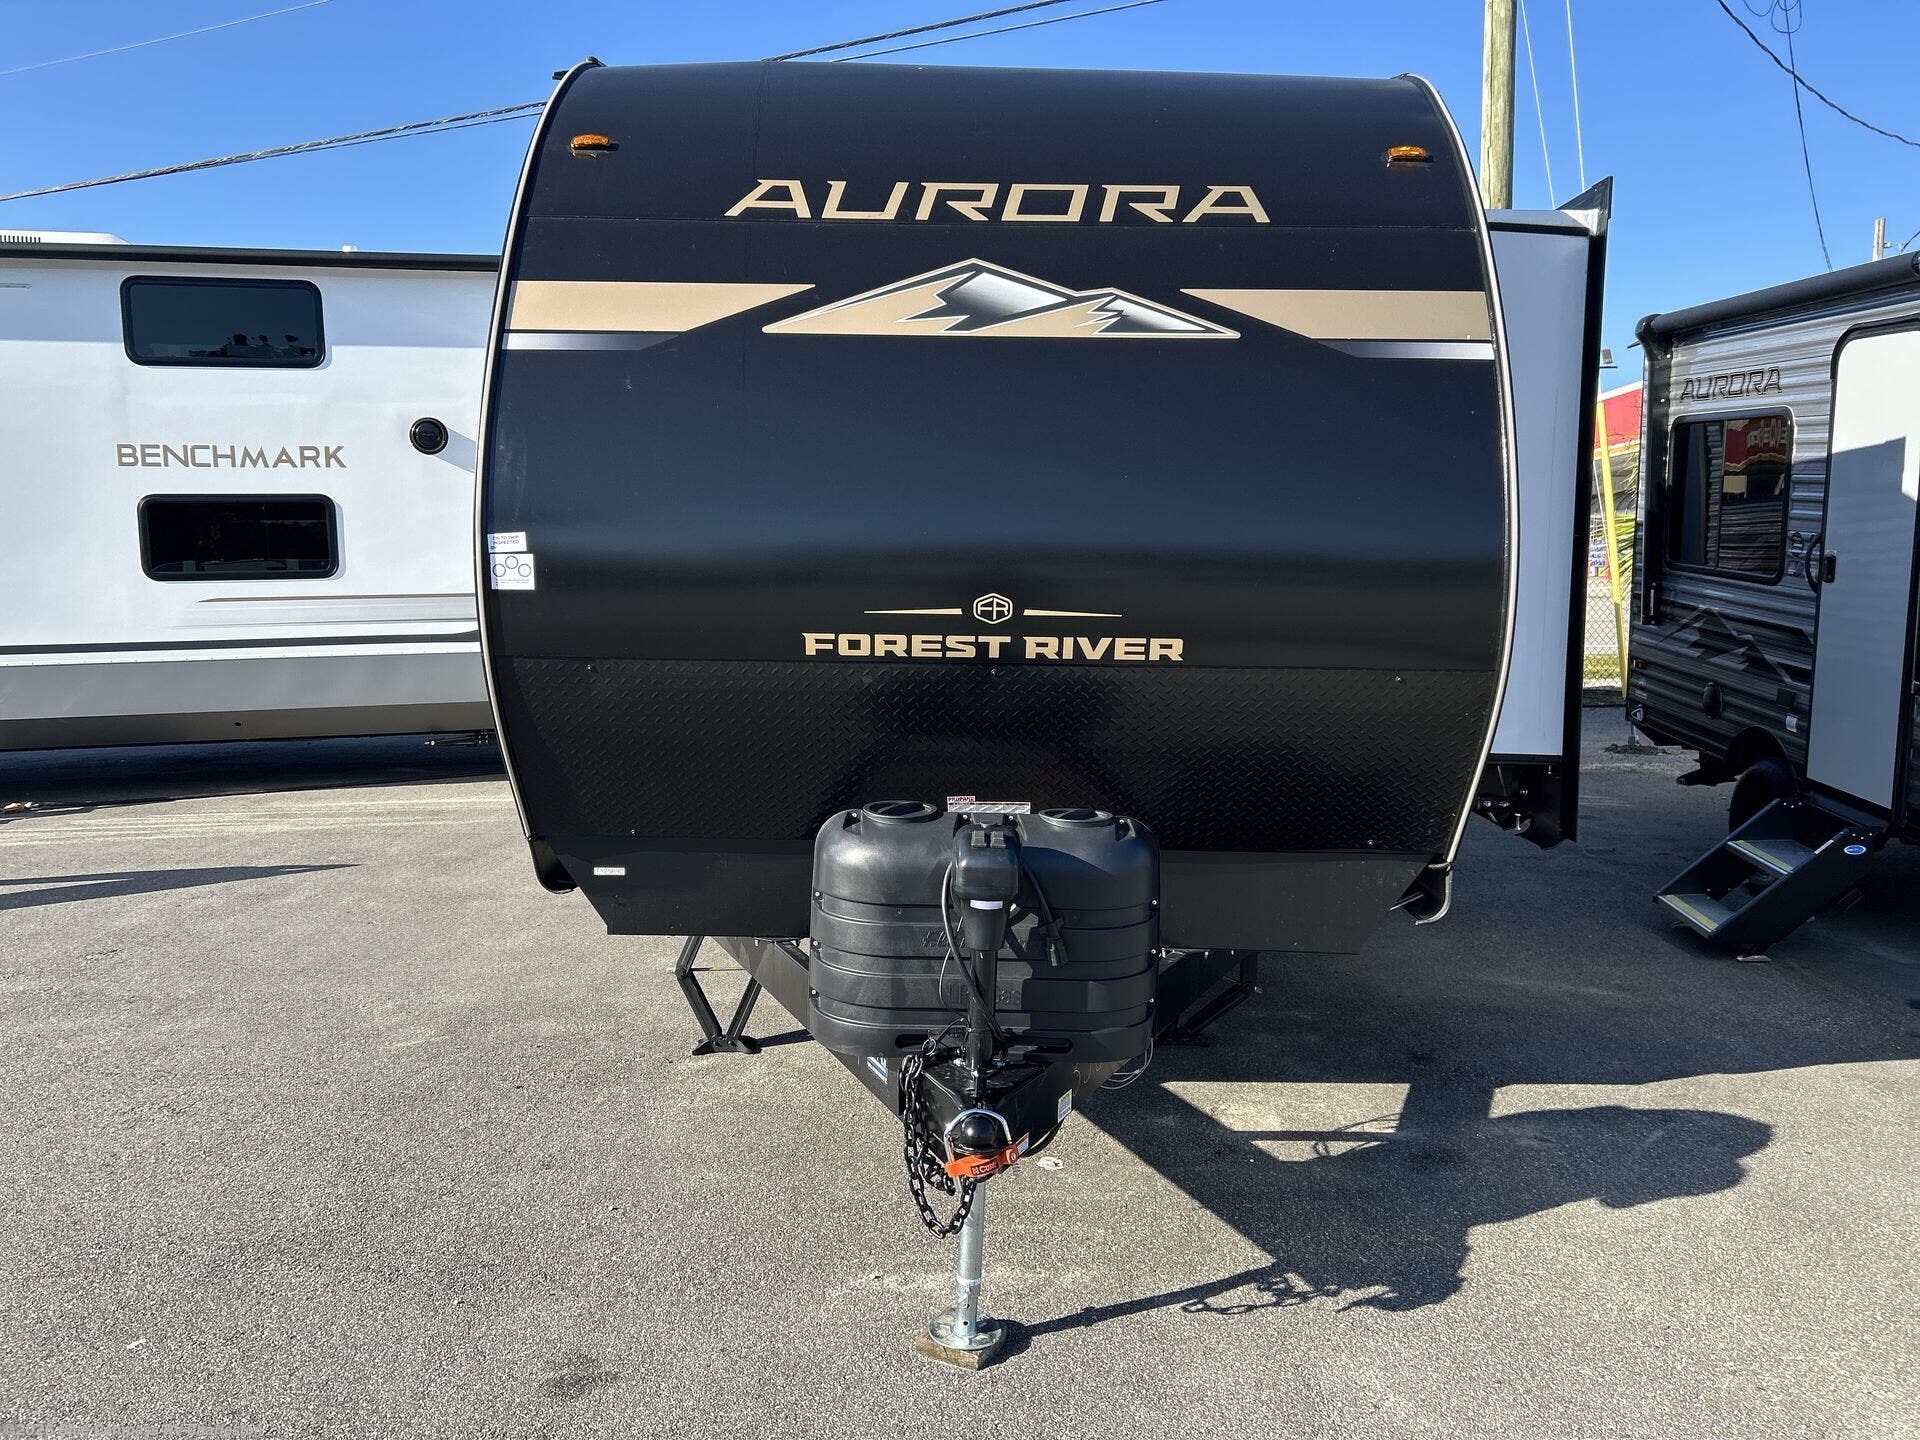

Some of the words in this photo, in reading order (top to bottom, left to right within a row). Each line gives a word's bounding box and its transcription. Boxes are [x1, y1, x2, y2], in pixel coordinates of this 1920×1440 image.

[724, 179, 1271, 223] AURORA
[1679, 366, 1783, 403] AURORA
[116, 443, 347, 468] BENCHMARK
[801, 632, 1011, 658] FOREST
[1023, 635, 1184, 661] RIVER
